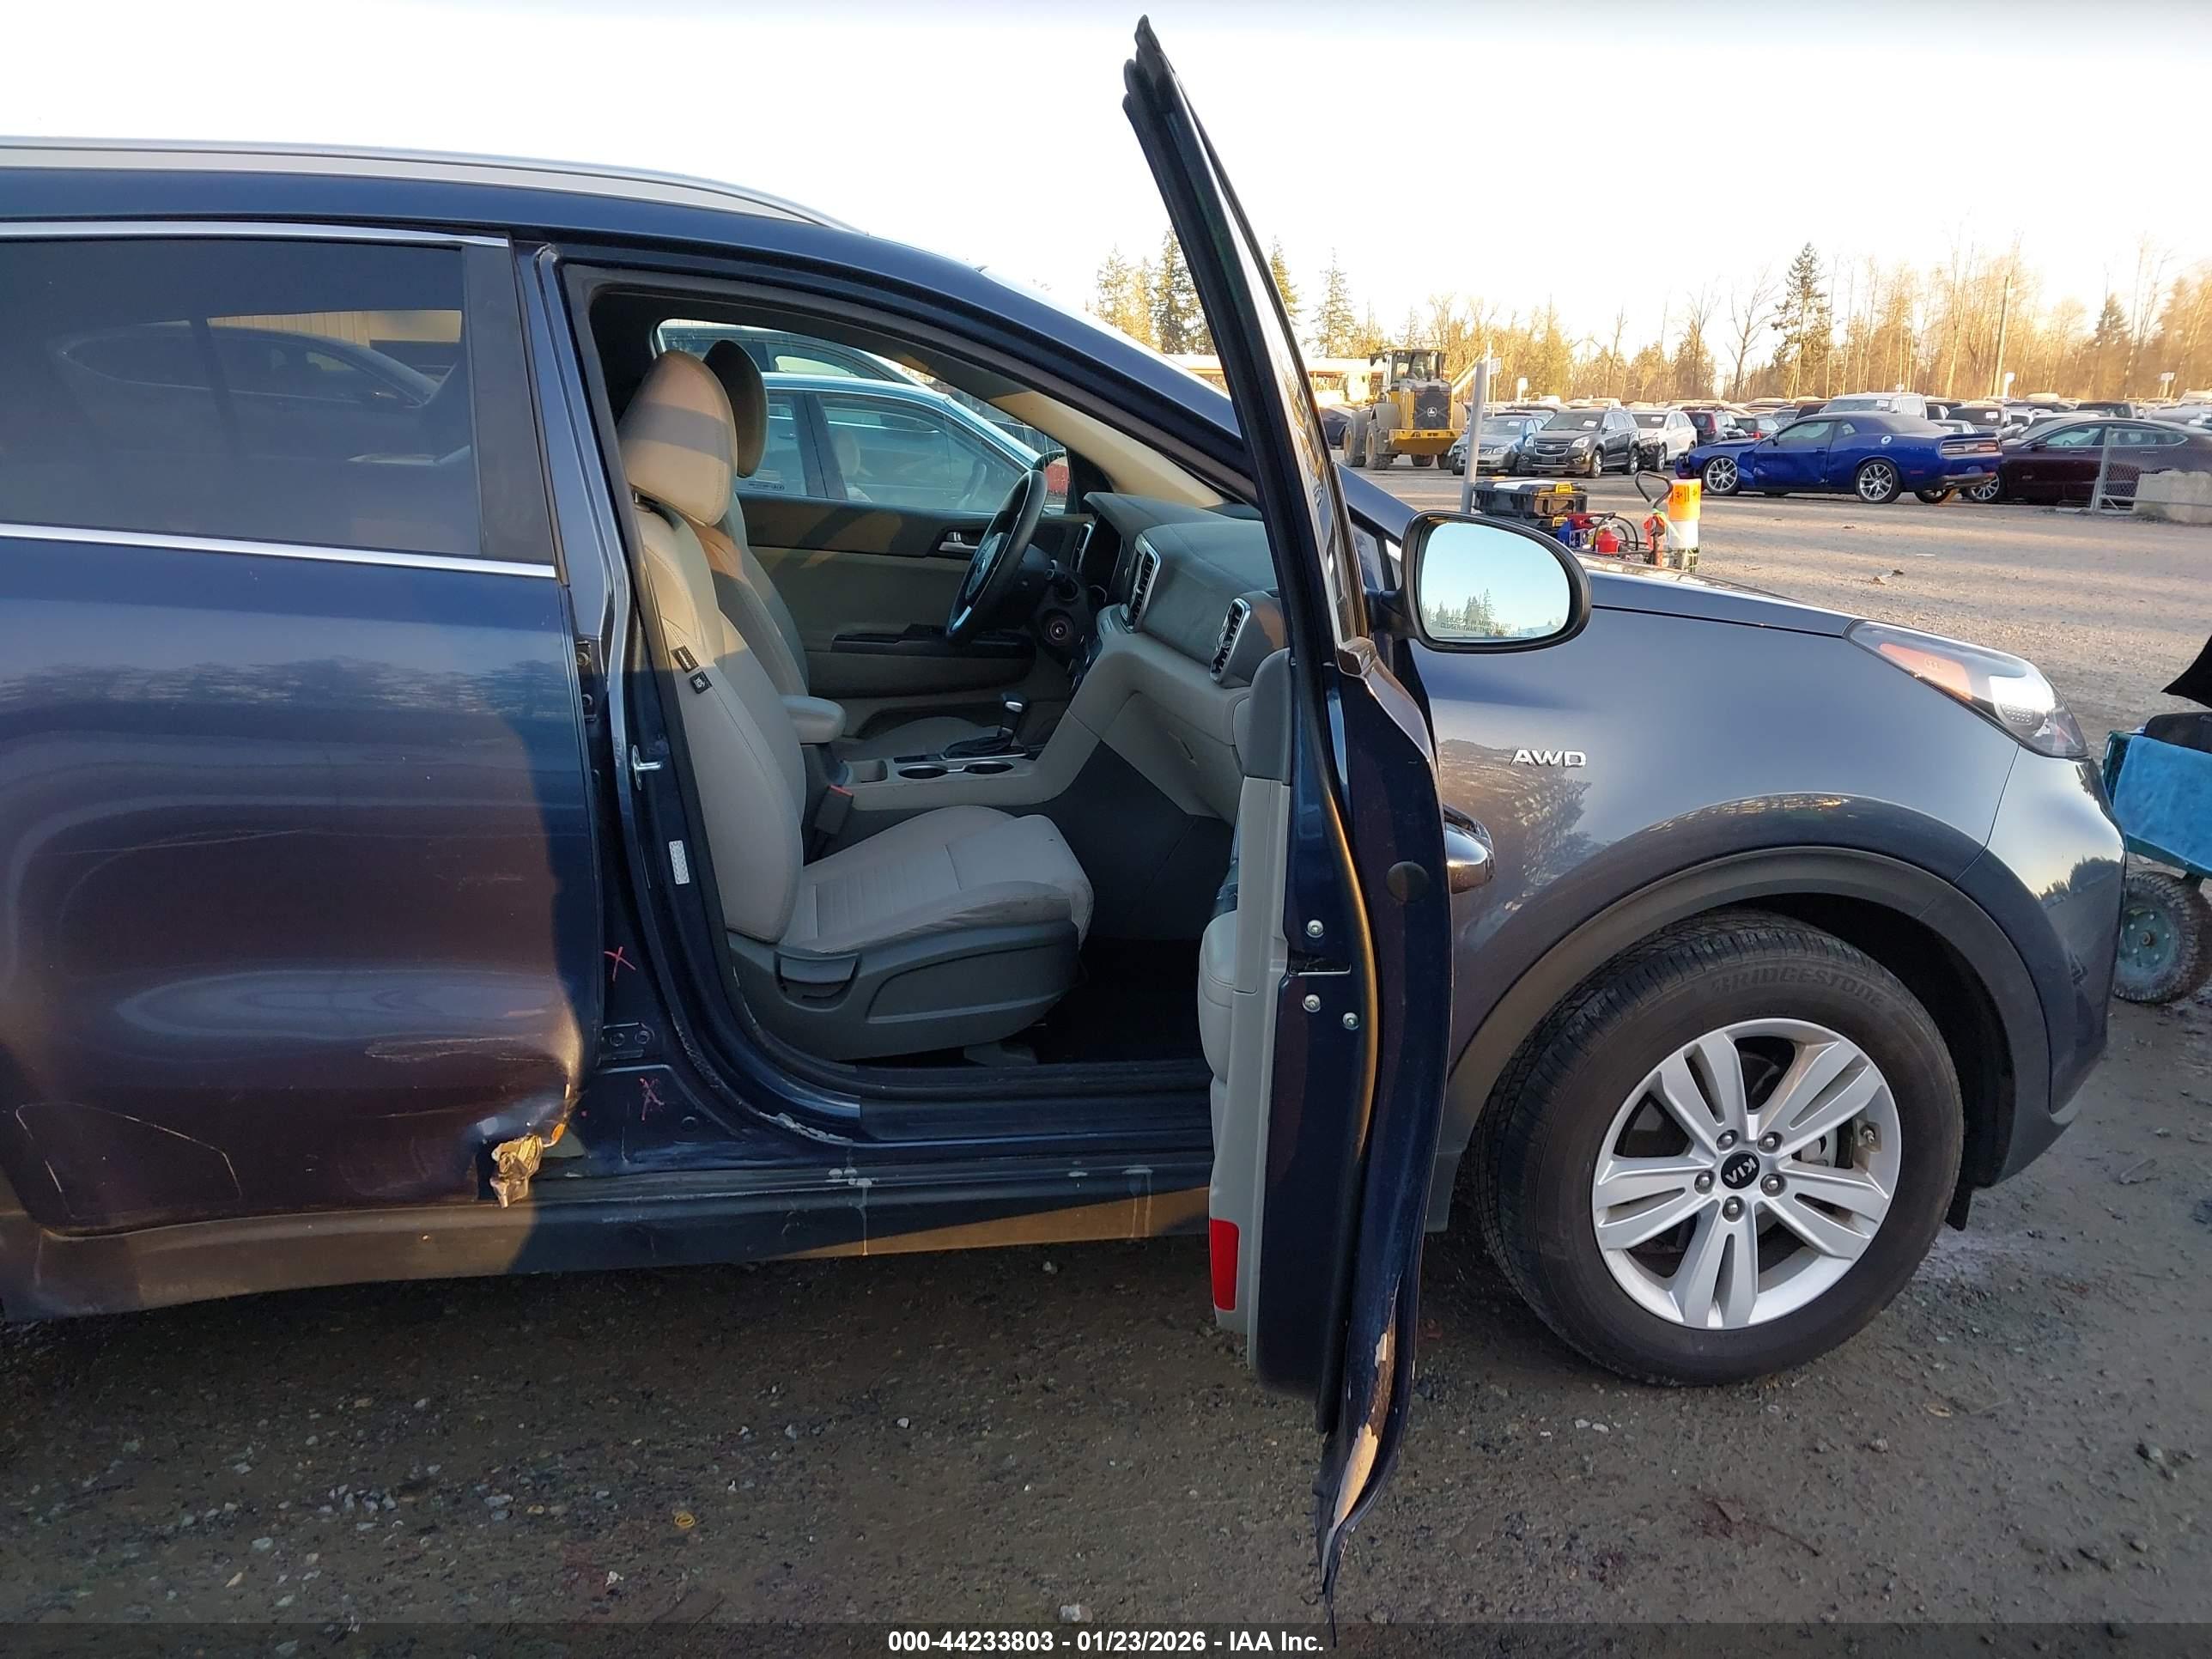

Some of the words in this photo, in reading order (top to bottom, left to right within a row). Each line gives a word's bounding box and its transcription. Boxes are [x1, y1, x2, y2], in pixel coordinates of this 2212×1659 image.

[1510, 749, 1587, 768] AWD
[1710, 966, 1887, 1009] BRIDGESTONE
[1724, 1157, 1757, 1183] KIA
